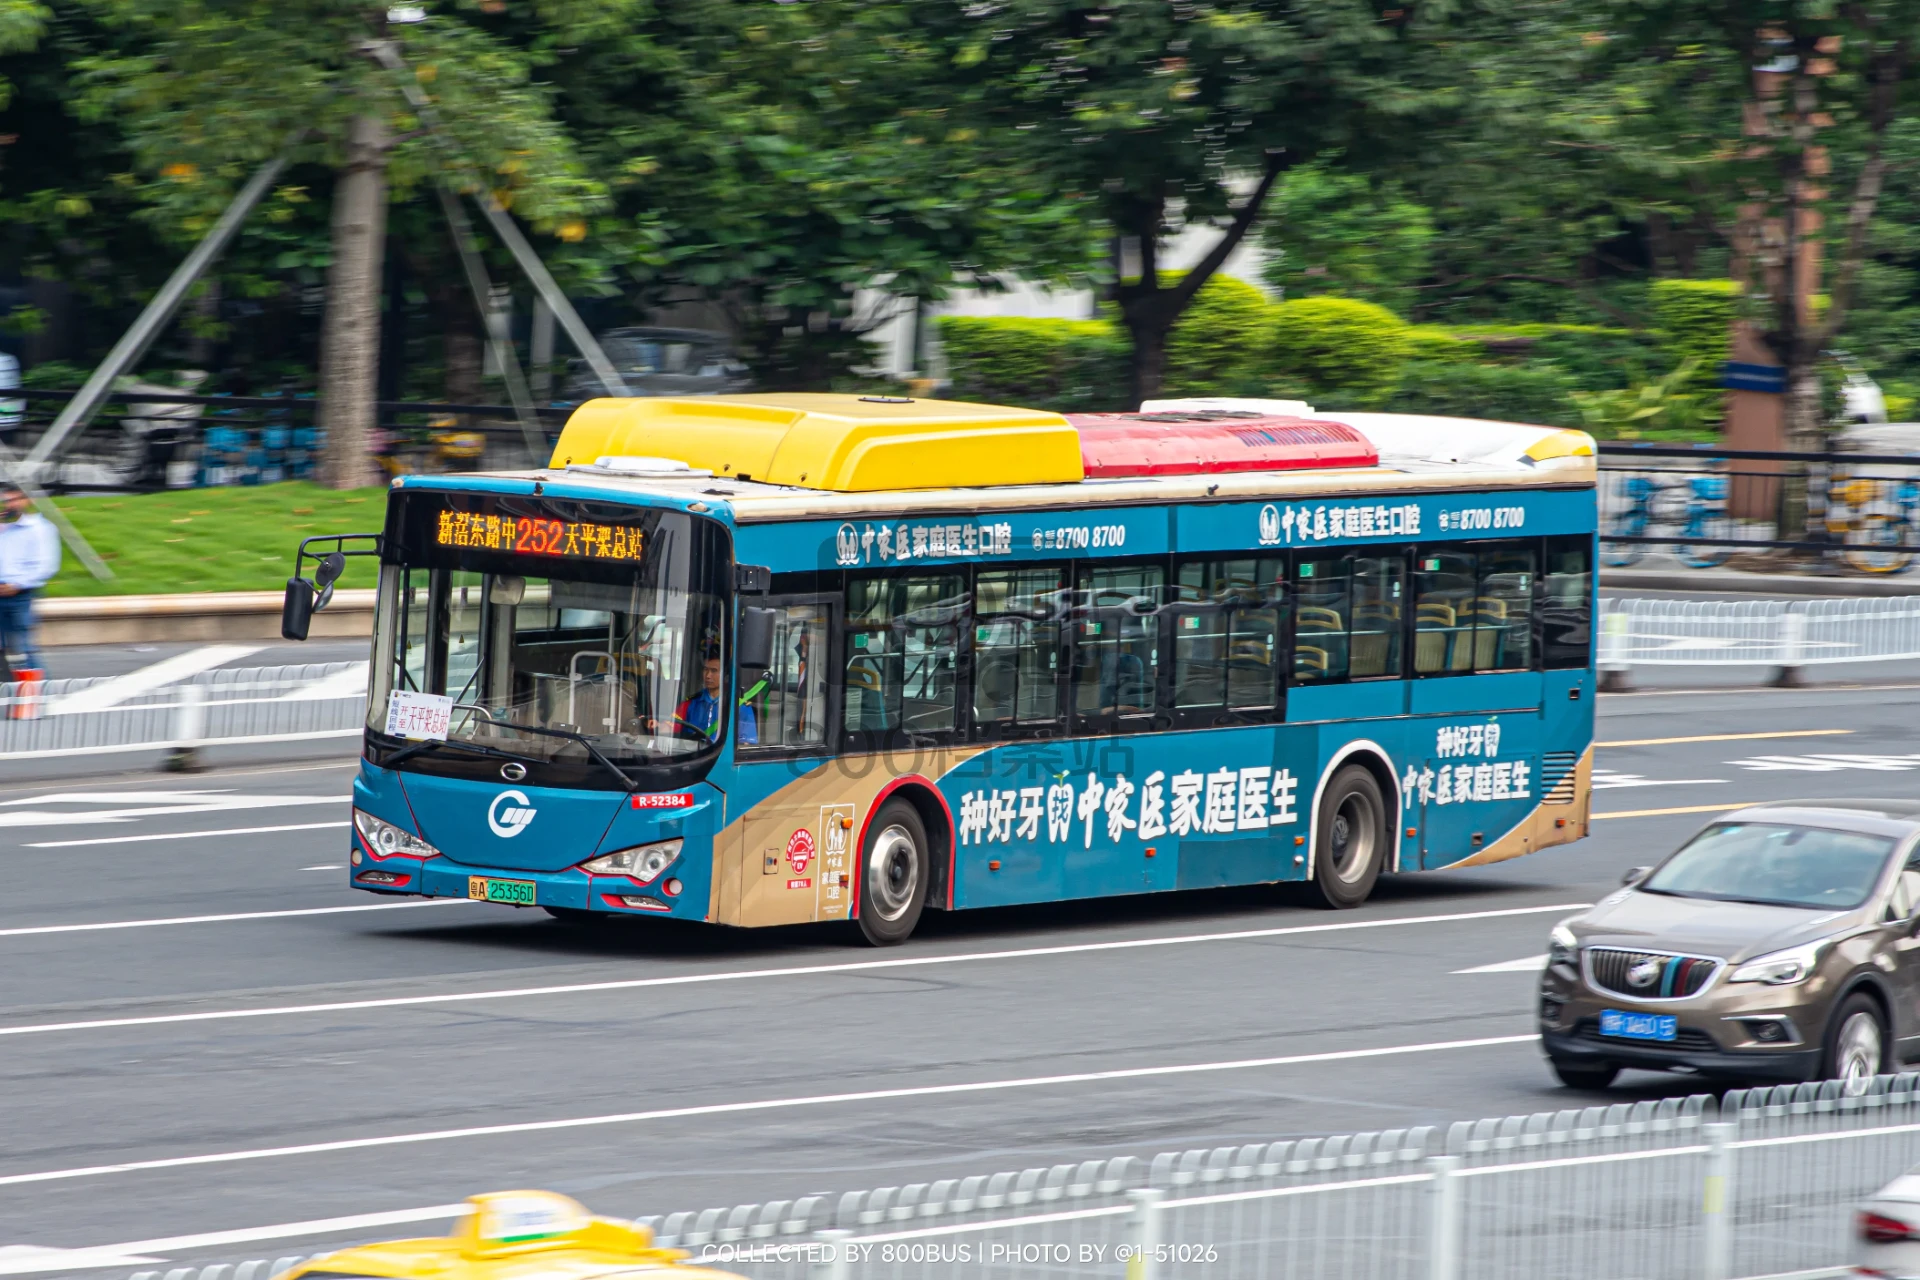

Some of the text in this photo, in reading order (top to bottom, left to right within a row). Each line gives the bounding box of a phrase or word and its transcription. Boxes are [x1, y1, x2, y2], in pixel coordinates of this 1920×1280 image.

[1460, 508, 1492, 530] 8700
[1493, 506, 1525, 529] 8700
[516, 517, 564, 554] 252
[564, 523, 643, 561] 天平架总站
[1055, 527, 1090, 550] 8700
[1092, 525, 1126, 548] 8700
[639, 795, 686, 807] R-52384
